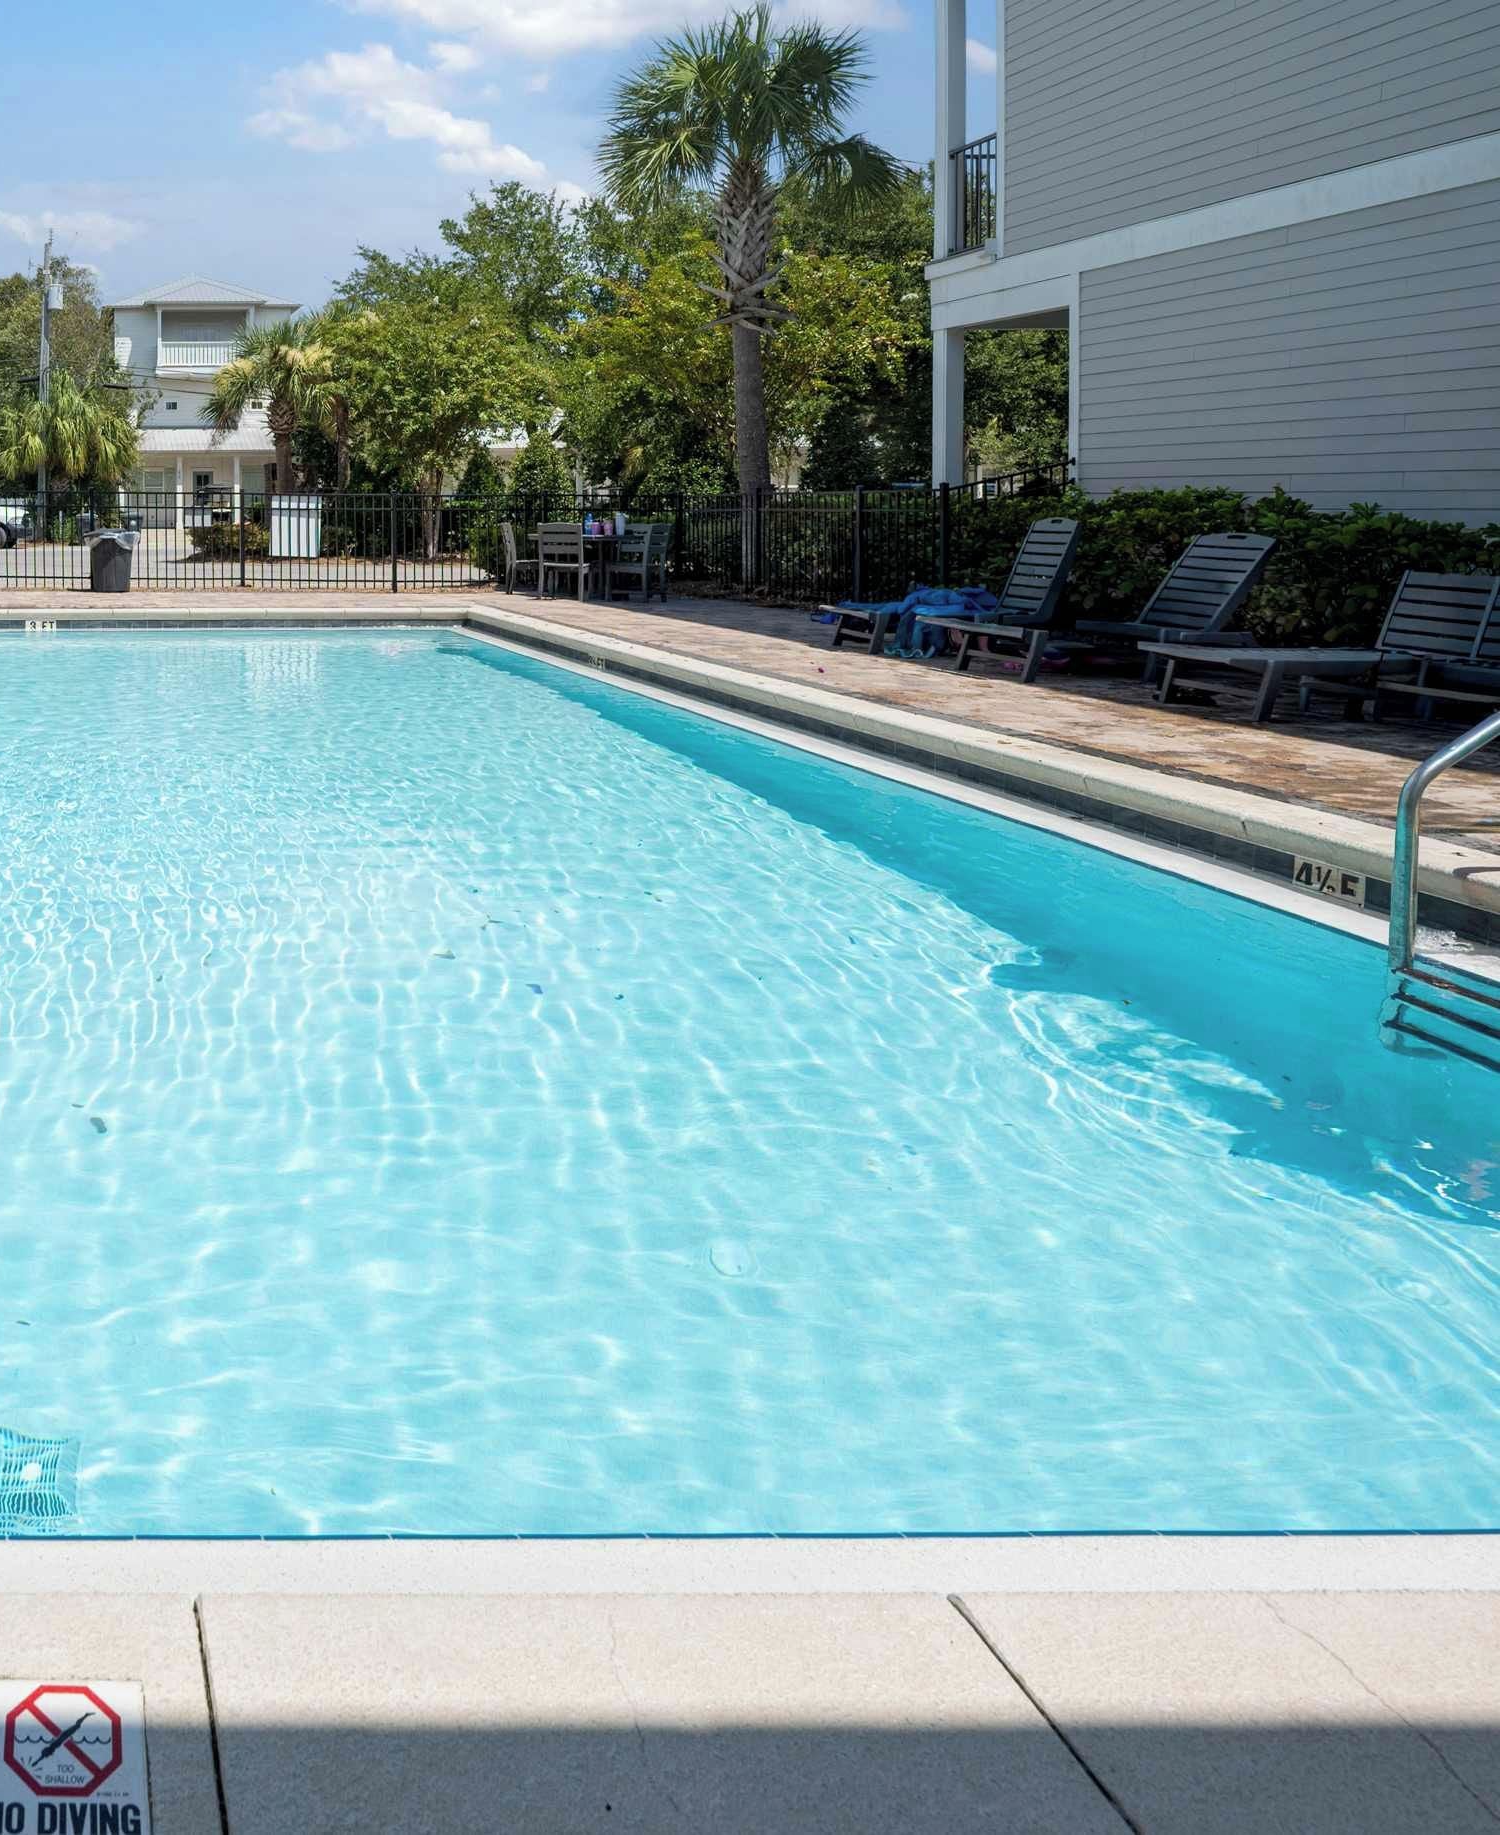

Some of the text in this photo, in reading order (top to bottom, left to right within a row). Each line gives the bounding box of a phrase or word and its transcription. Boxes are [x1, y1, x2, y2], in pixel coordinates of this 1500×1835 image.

[41, 620, 55, 630] FT
[57, 1764, 75, 1773] TOO
[44, 1774, 85, 1785] SHALLOW
[37, 1801, 141, 1835] DIVING
